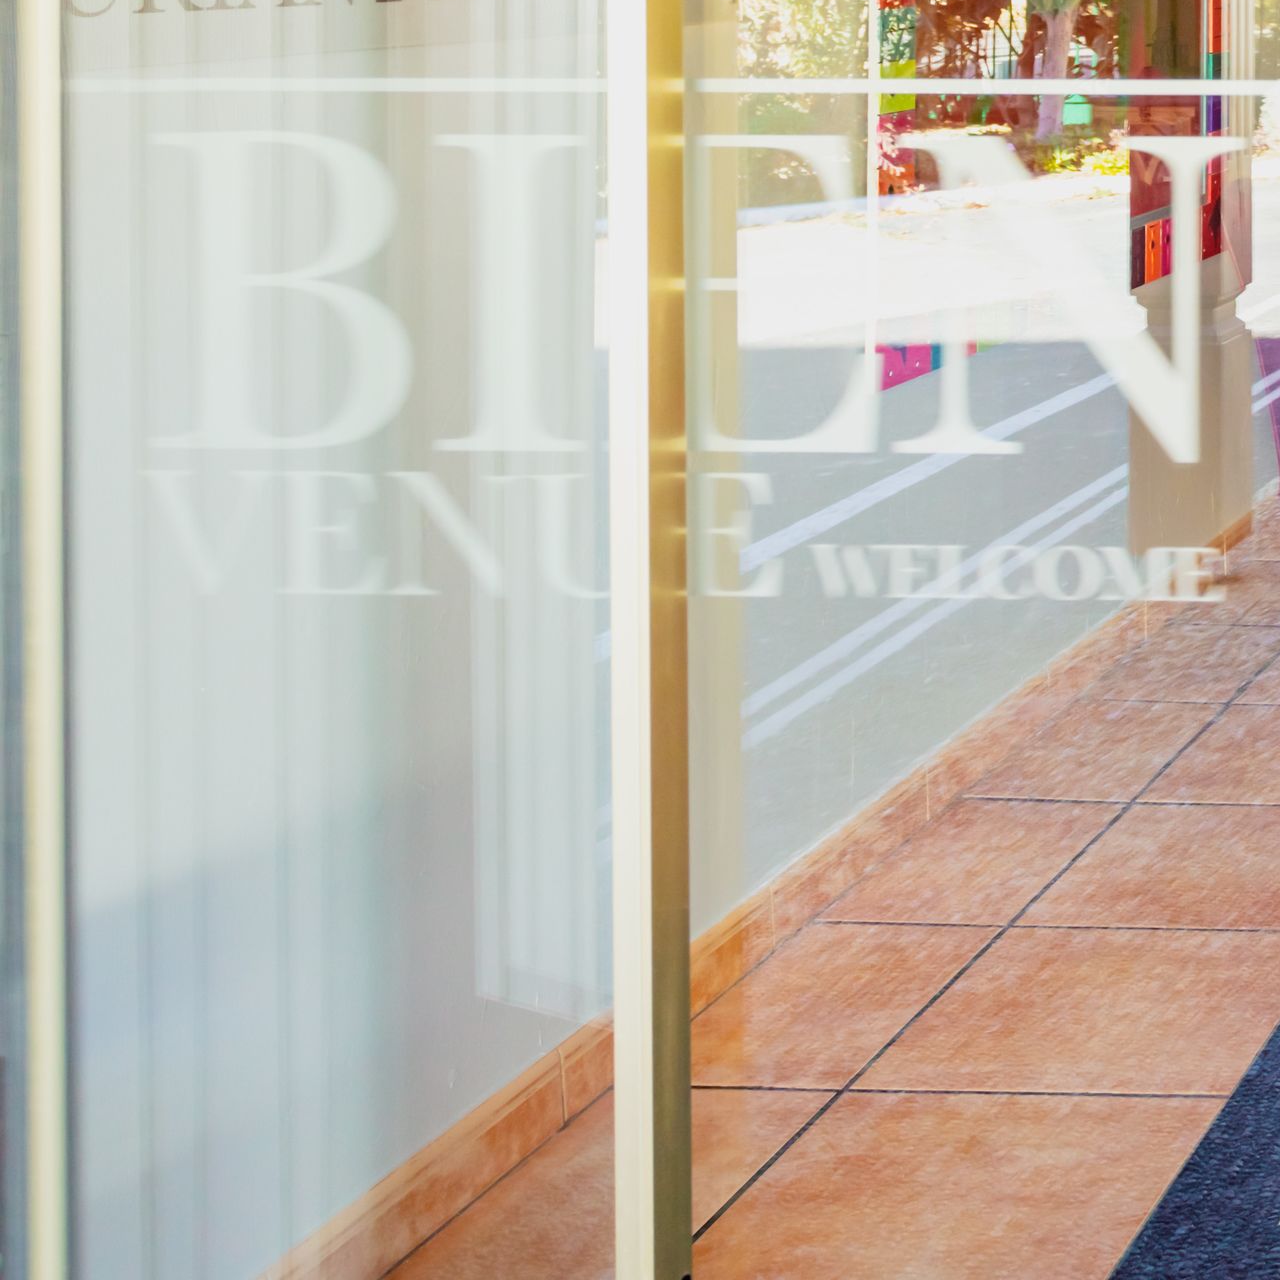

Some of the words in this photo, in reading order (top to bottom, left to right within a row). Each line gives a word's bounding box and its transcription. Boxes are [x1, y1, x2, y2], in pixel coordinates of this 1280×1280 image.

[145, 130, 1250, 464] BIEN
[138, 471, 784, 600] VENUE
[810, 544, 1229, 603] WELCOME
